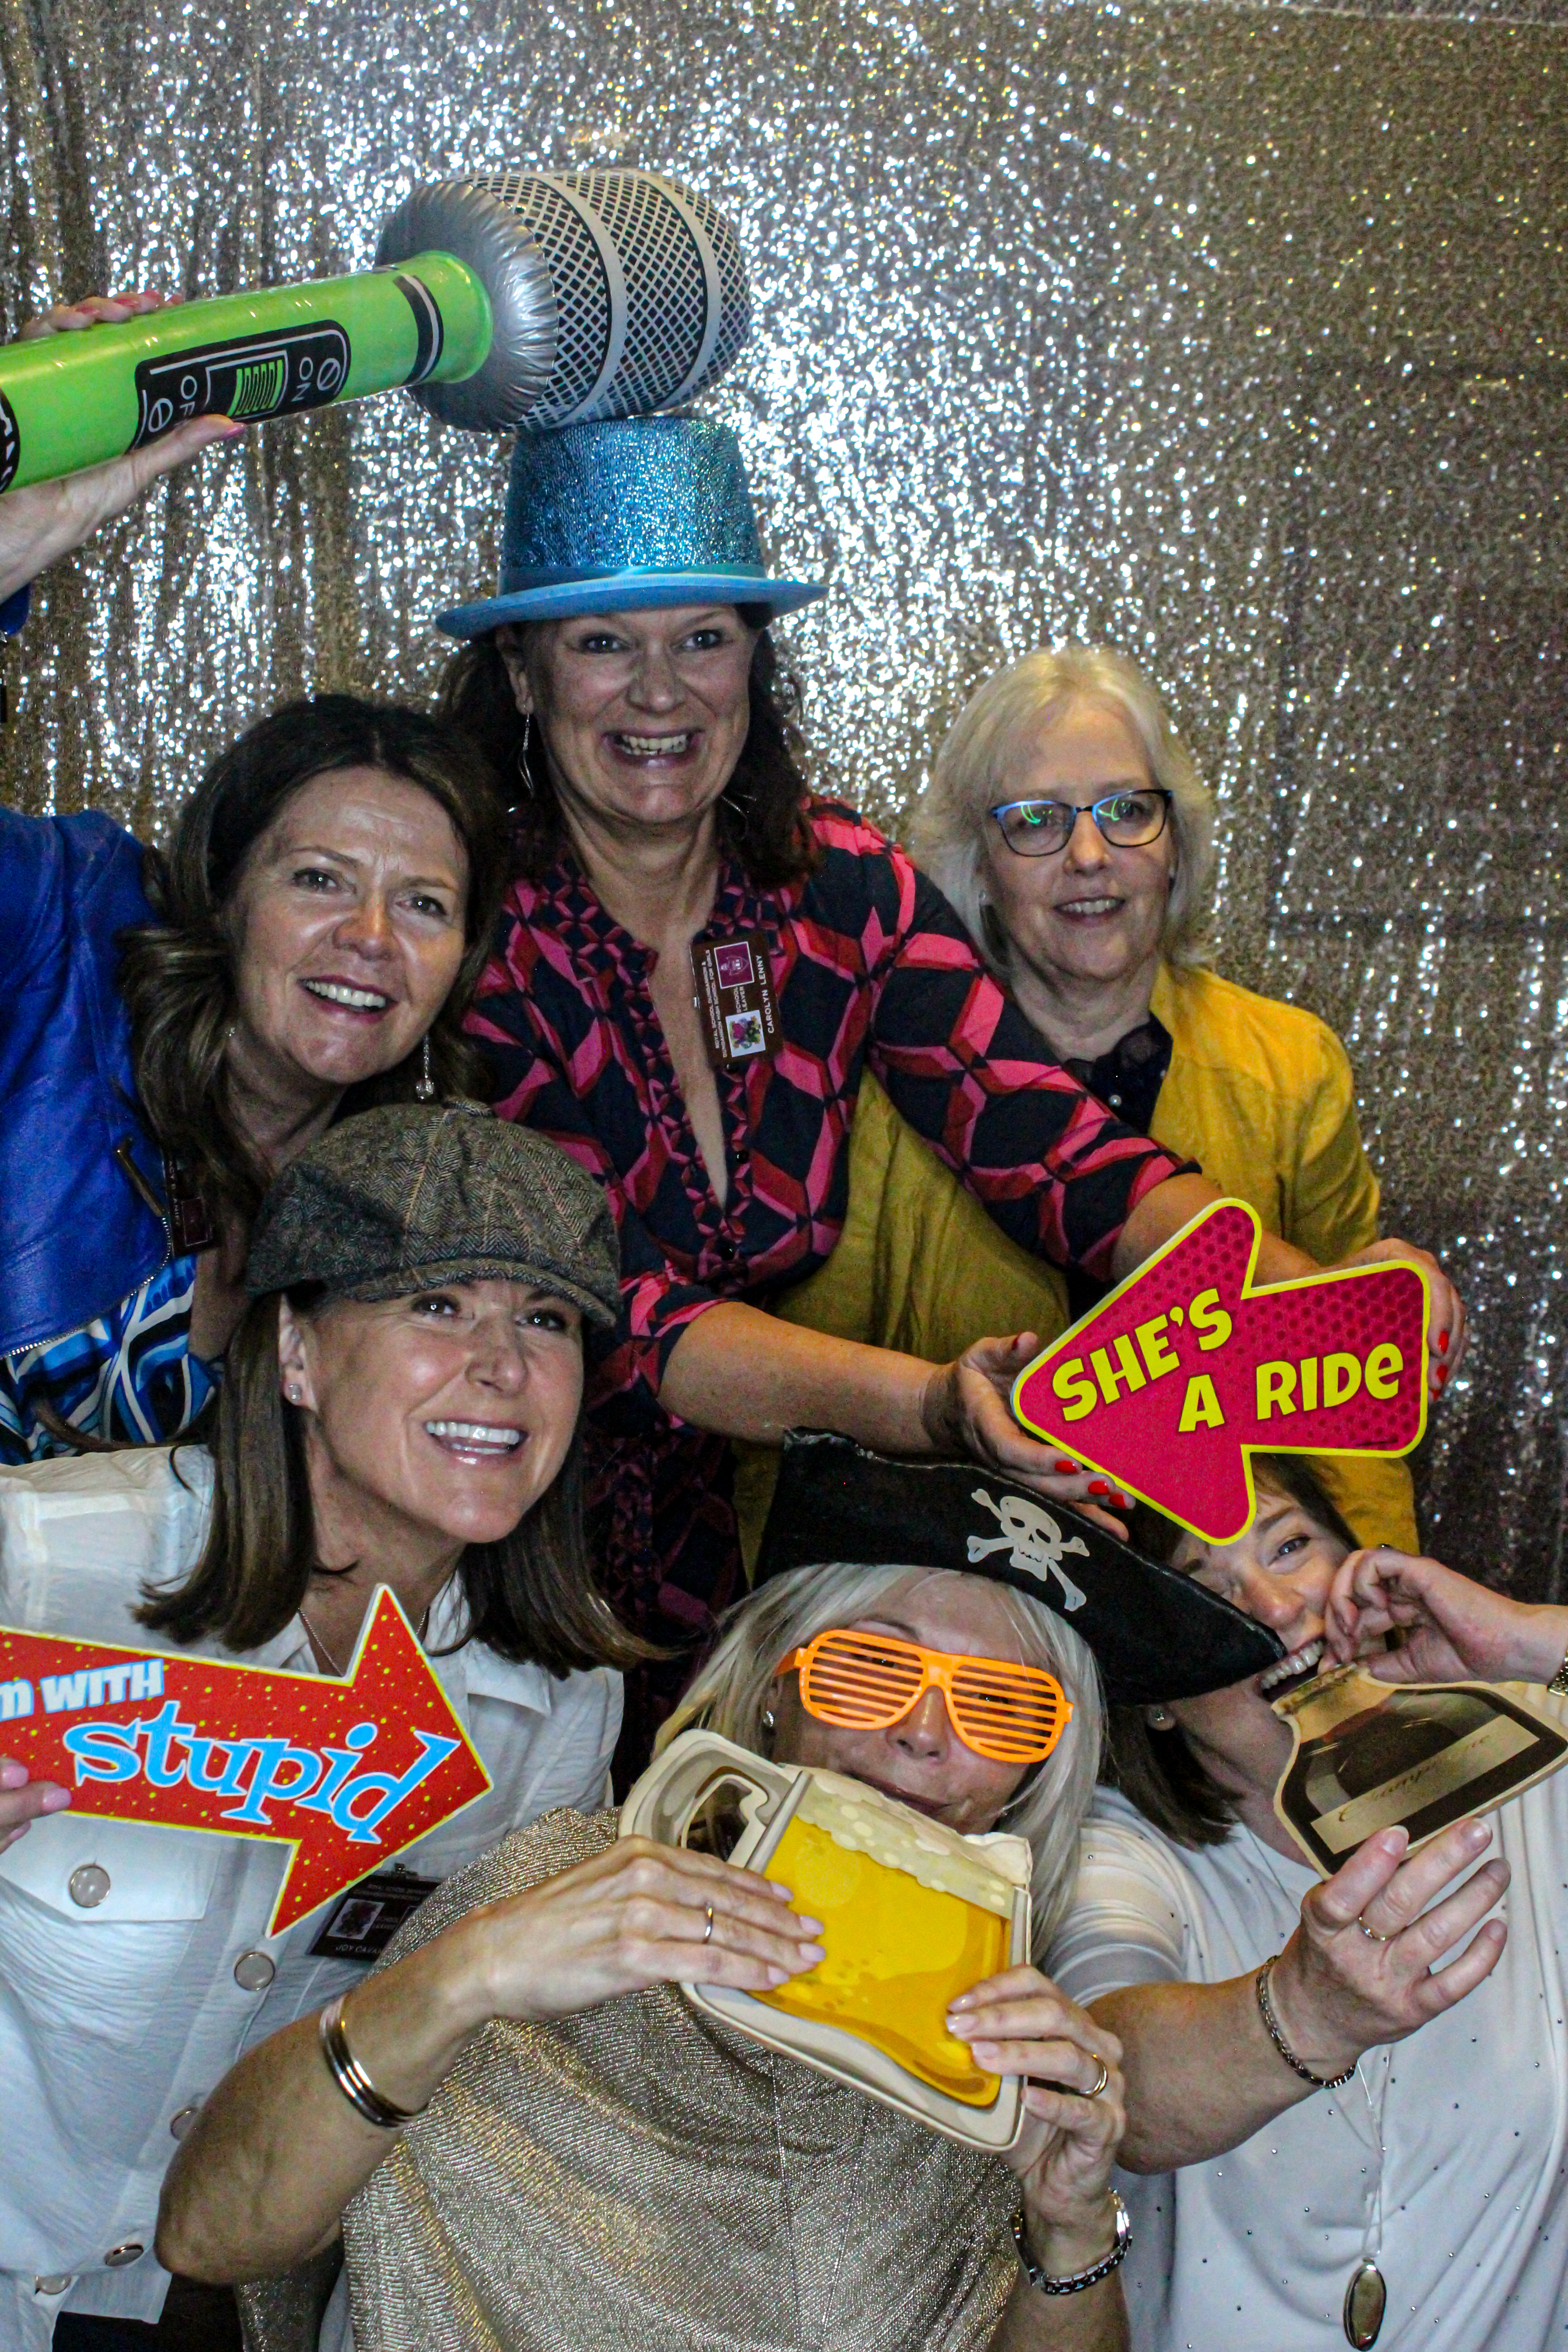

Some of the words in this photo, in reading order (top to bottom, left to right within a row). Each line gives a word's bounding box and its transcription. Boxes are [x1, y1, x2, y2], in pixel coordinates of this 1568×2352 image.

[174, 375, 197, 426] OF
[291, 357, 313, 402] ON
[756, 954, 766, 985] LENNY
[762, 989, 774, 1034] CAROLYN
[1053, 1288, 1232, 1421] SHE'S
[1179, 1374, 1225, 1432] A
[40, 1658, 164, 1713] WITH
[63, 1700, 461, 1844] stupid
